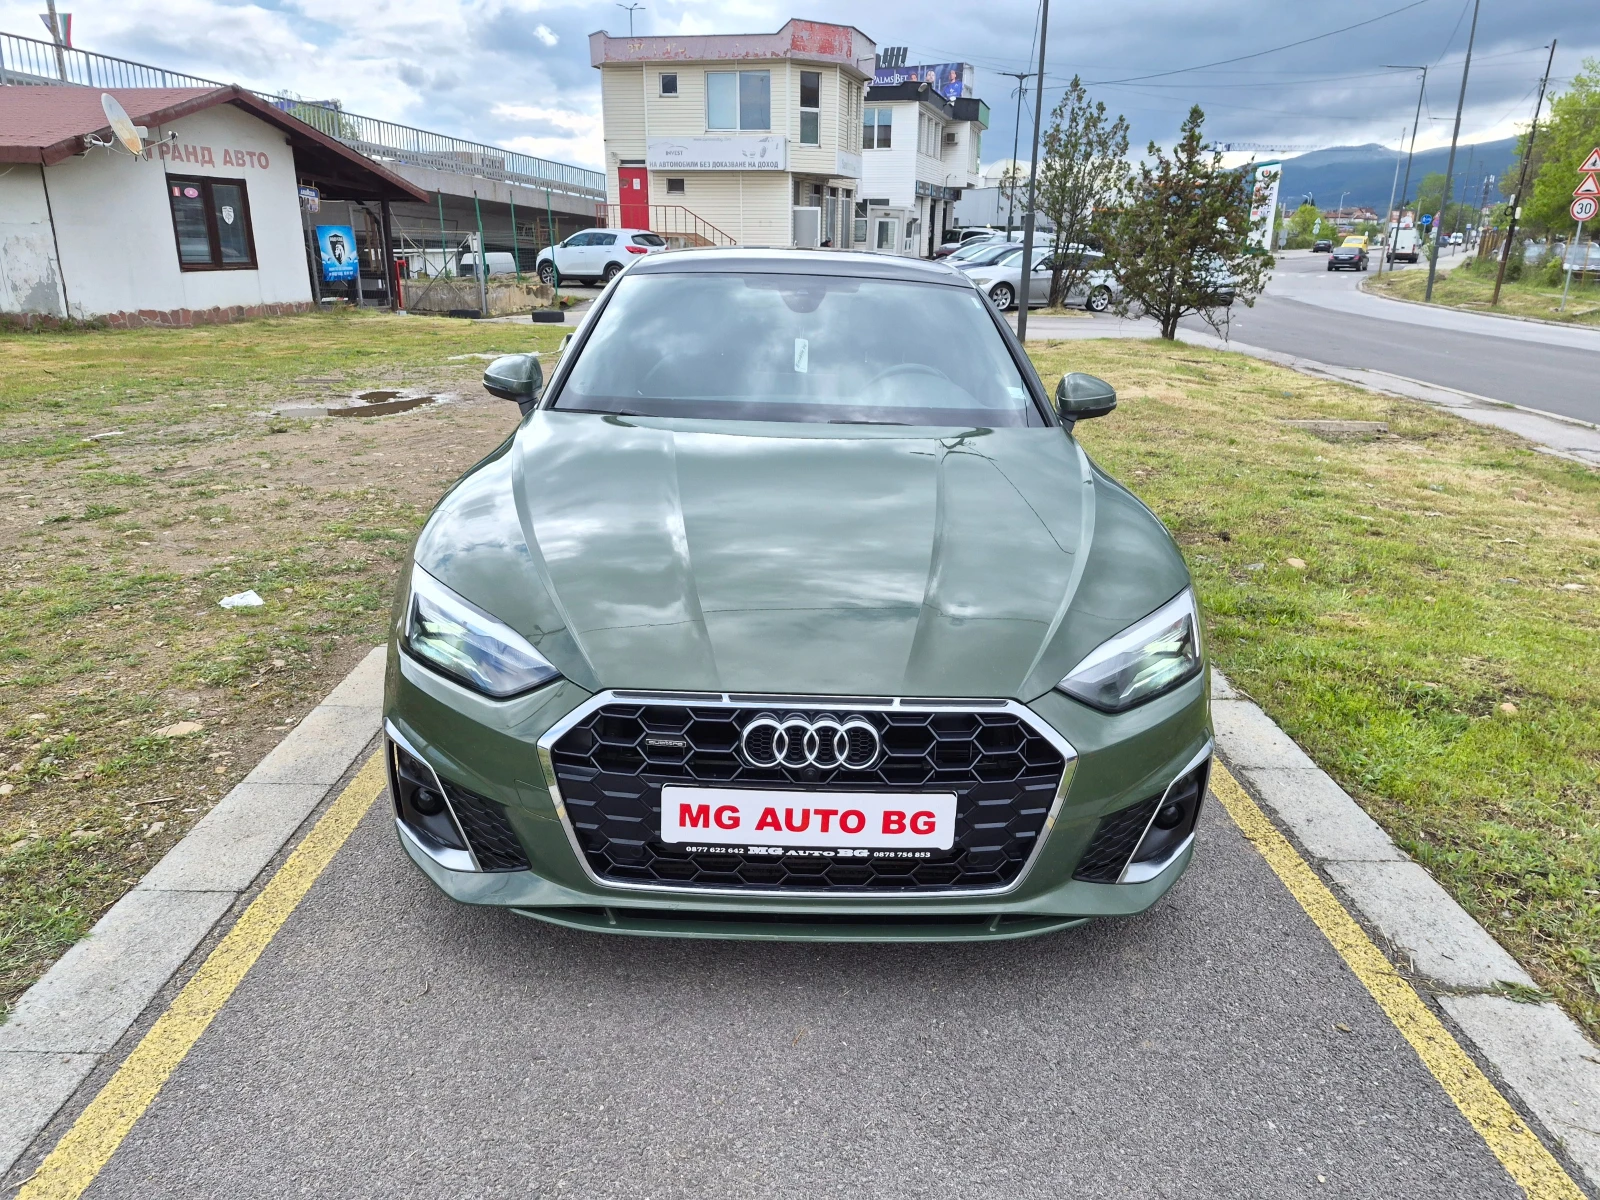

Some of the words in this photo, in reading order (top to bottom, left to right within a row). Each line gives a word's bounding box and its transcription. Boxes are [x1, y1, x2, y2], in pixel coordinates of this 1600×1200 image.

[145, 140, 215, 168] ГРАНД
[223, 148, 270, 170] АВТО
[757, 161, 779, 169] ДОХОД
[1576, 202, 1592, 215] 30
[679, 803, 741, 829] MG
[754, 806, 866, 833] AUTO
[881, 810, 936, 835] BG
[747, 846, 784, 856] MG
[836, 848, 870, 857] BG
